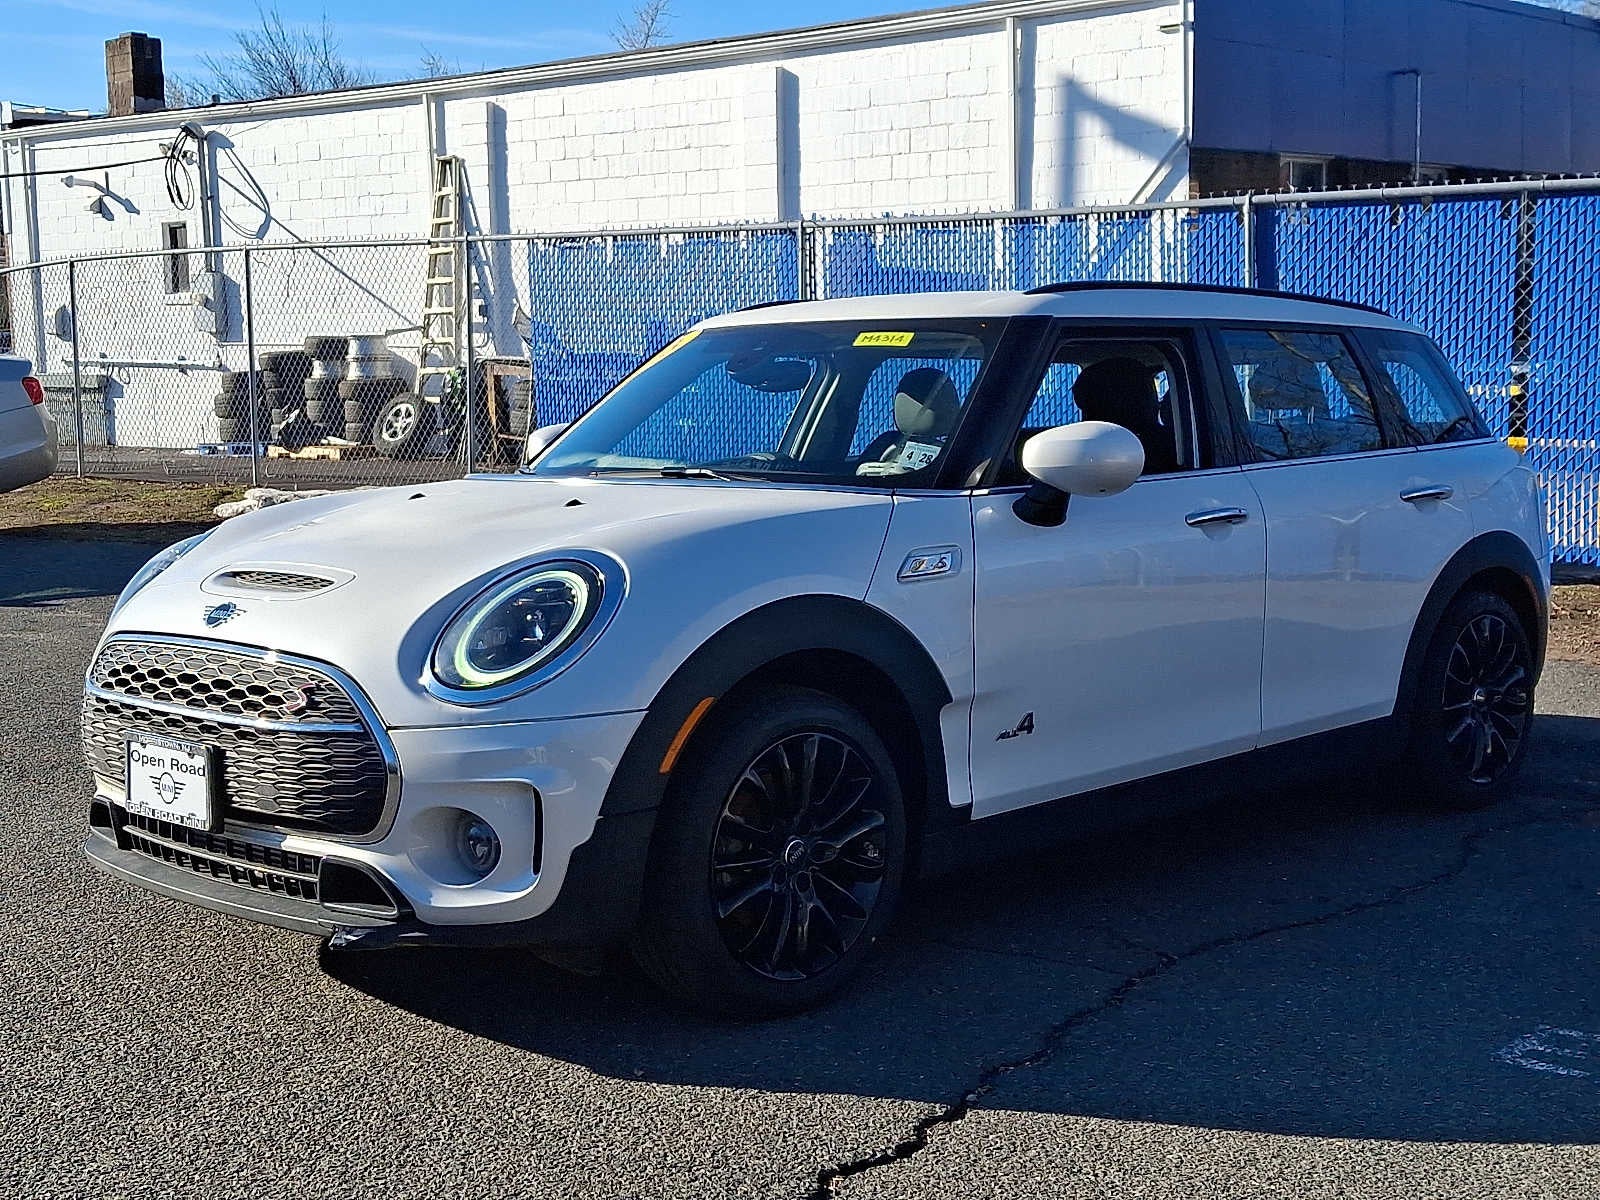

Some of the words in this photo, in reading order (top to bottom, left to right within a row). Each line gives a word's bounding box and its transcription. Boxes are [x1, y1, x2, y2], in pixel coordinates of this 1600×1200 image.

[906, 450, 915, 461] 4
[918, 452, 934, 464] 28
[130, 749, 165, 769] Open
[170, 757, 206, 777] Road
[129, 803, 153, 816] OPEN
[154, 809, 181, 822] ROAD
[183, 816, 205, 829] MINI
